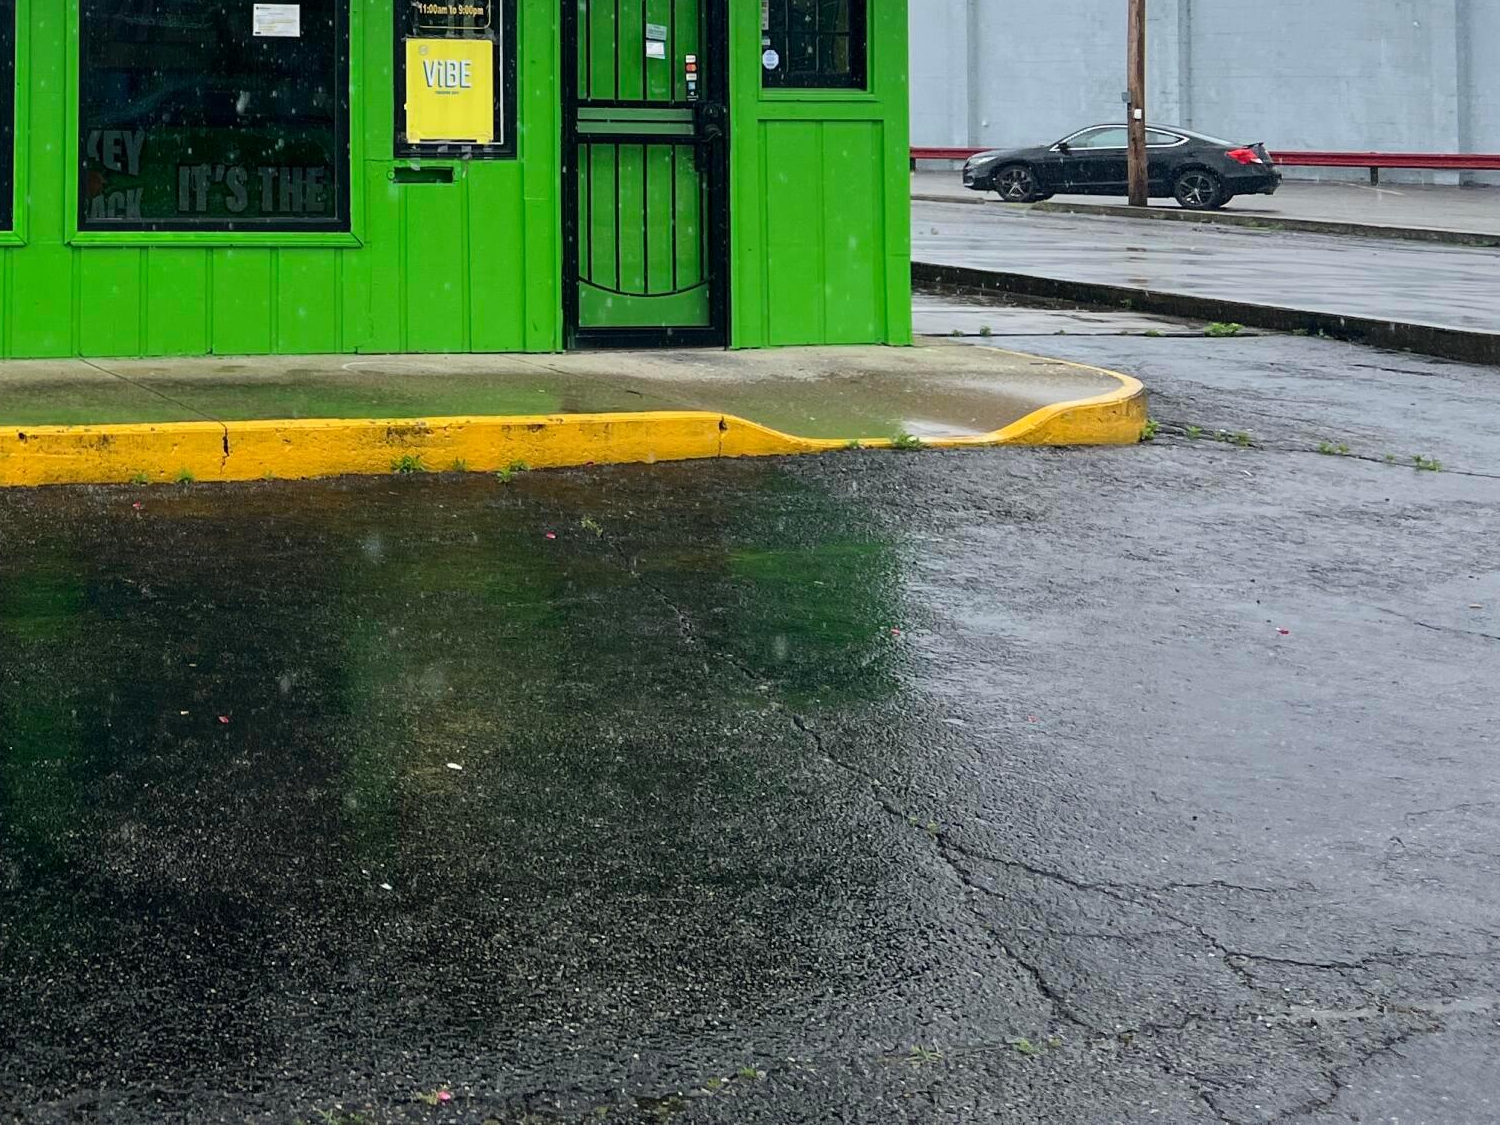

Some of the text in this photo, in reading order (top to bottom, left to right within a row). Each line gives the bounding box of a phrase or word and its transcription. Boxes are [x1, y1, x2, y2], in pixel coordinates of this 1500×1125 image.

[419, 3, 448, 15] 11:00am
[458, 4, 484, 17] 9:00pm
[84, 185, 143, 220] ACK
[177, 162, 328, 213] IT'S THE
